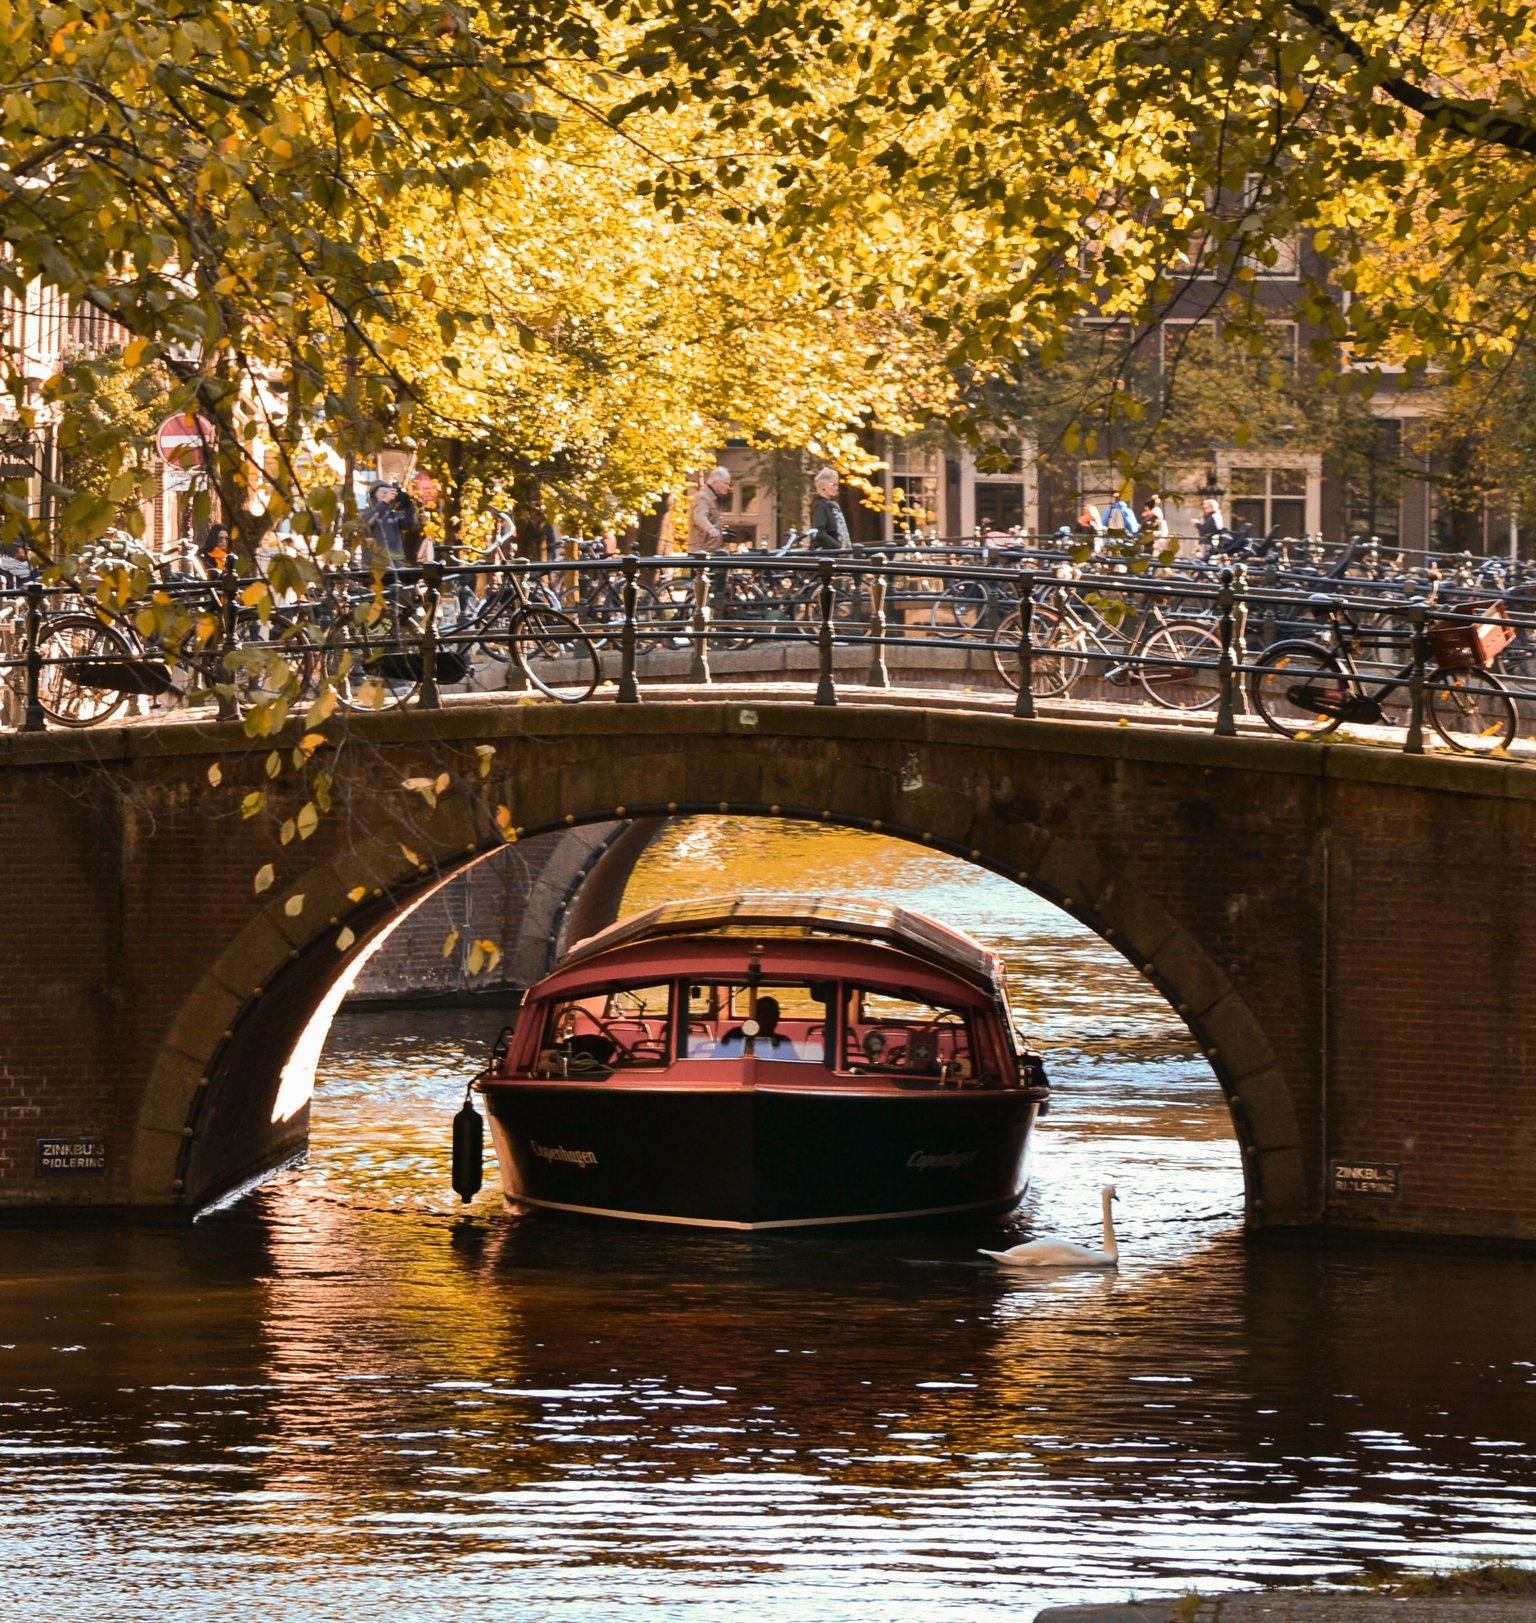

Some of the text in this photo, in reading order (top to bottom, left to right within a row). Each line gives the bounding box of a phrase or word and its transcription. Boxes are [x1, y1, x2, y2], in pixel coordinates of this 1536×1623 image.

[43, 1144, 104, 1156] ZINKBUS
[529, 1140, 599, 1168] Copenhagen
[1335, 1166, 1395, 1181] ZINKBUS
